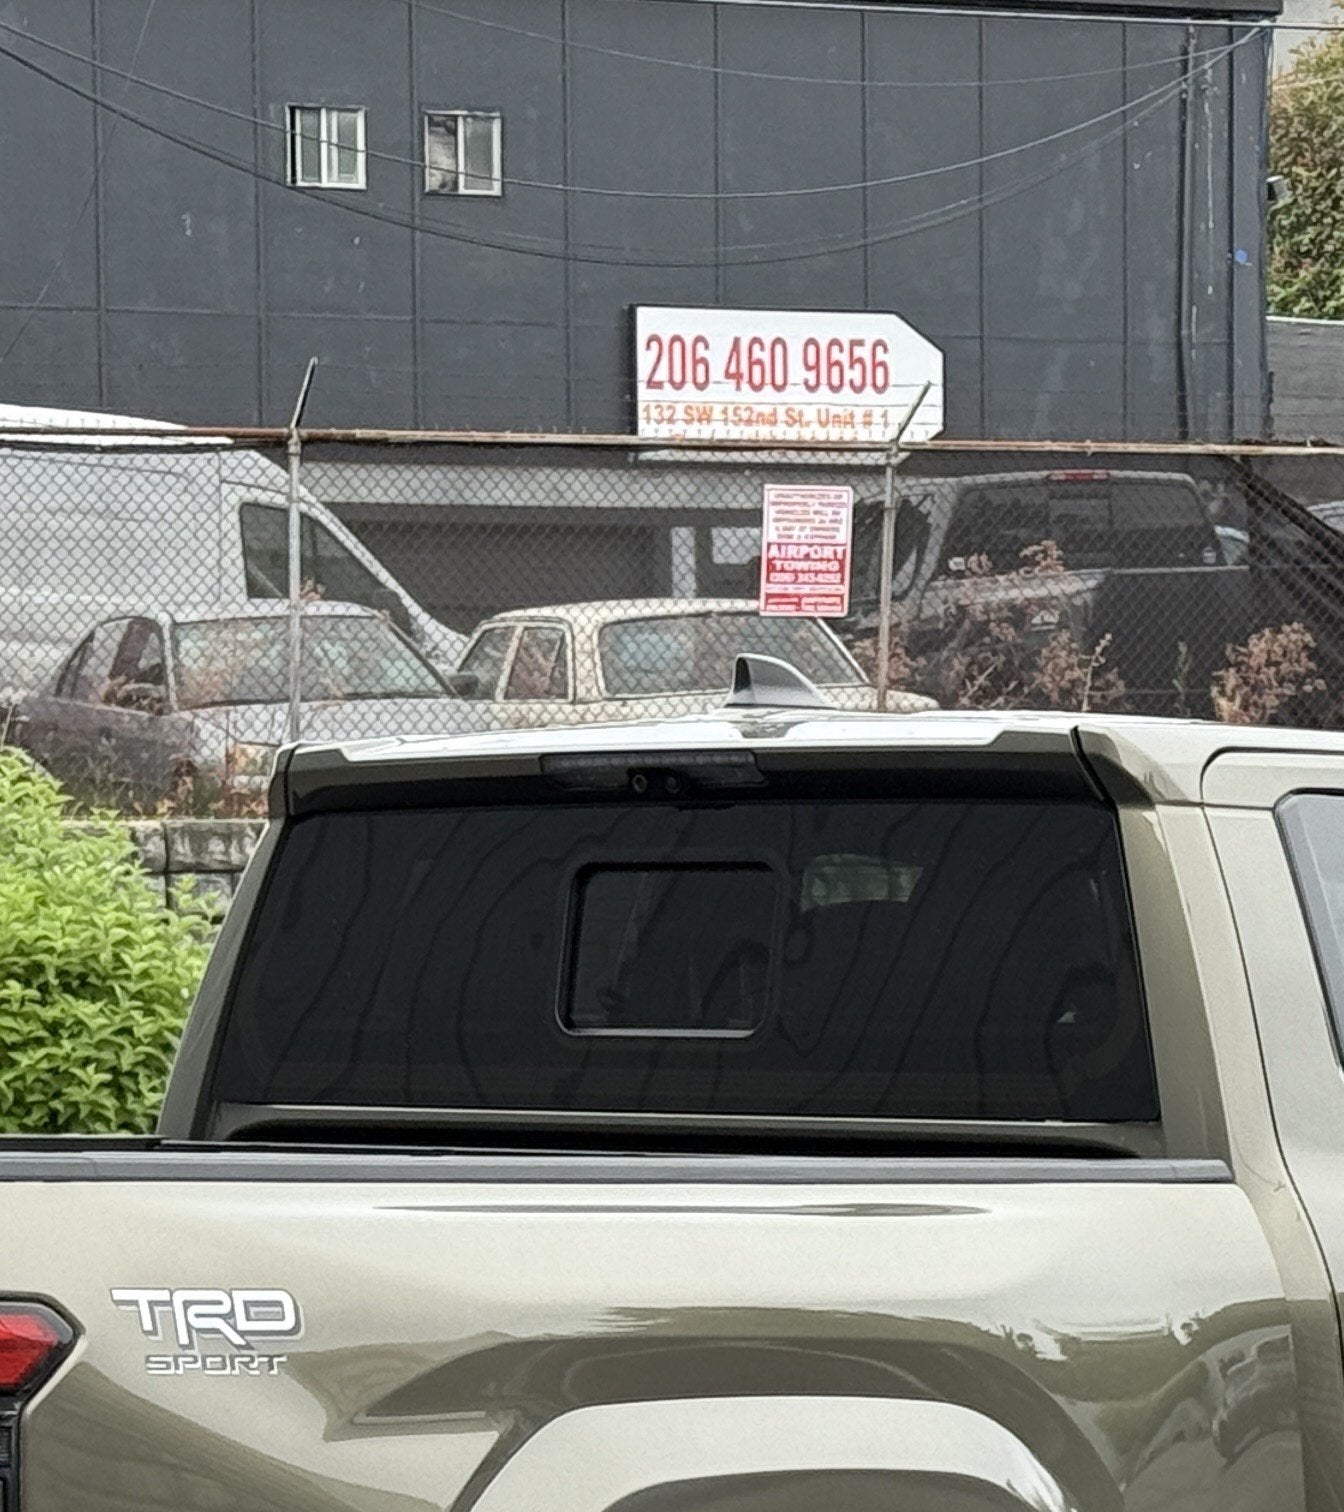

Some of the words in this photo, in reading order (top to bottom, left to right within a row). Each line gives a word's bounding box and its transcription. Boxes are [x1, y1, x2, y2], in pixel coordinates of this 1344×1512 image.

[645, 334, 710, 391] 206
[724, 336, 788, 392] 460
[803, 337, 889, 394] 9656
[643, 404, 676, 425] 132
[683, 405, 713, 425] SW
[722, 405, 777, 426] 152nd
[785, 406, 810, 427] St.
[817, 408, 855, 428] Unit
[768, 544, 847, 559] AIRPORT
[771, 560, 840, 572] TOWING
[111, 1288, 301, 1350] TRD
[145, 1354, 287, 1376] SPORT
